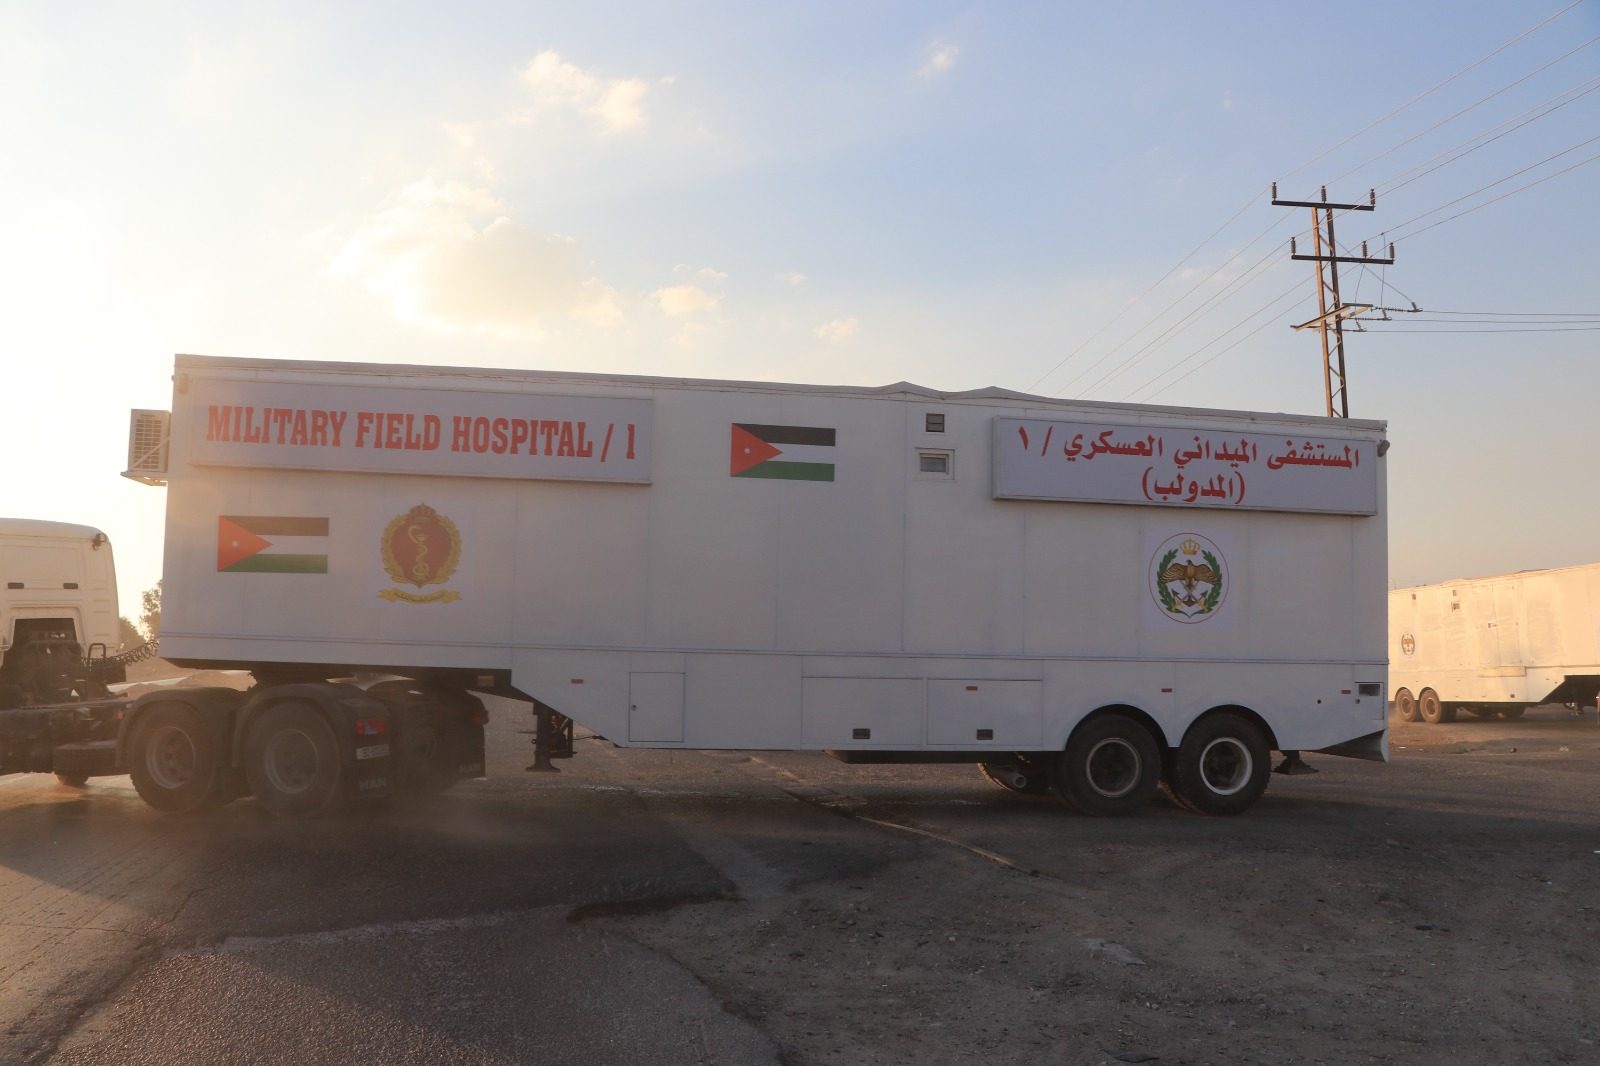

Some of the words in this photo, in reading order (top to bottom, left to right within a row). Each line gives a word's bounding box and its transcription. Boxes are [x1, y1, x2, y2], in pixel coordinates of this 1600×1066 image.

[206, 405, 347, 447] MILITARY
[355, 411, 441, 451] FIELD
[451, 416, 593, 458] HOSPITAL
[600, 423, 614, 463] /
[626, 423, 635, 460] 1
[1018, 426, 1029, 450] ١
[1041, 426, 1053, 457] /
[1064, 430, 1162, 461] العسكري
[1174, 435, 1257, 469] الميداني
[1267, 440, 1359, 470] المستشفى
[1142, 466, 1246, 504] (المدولب)
